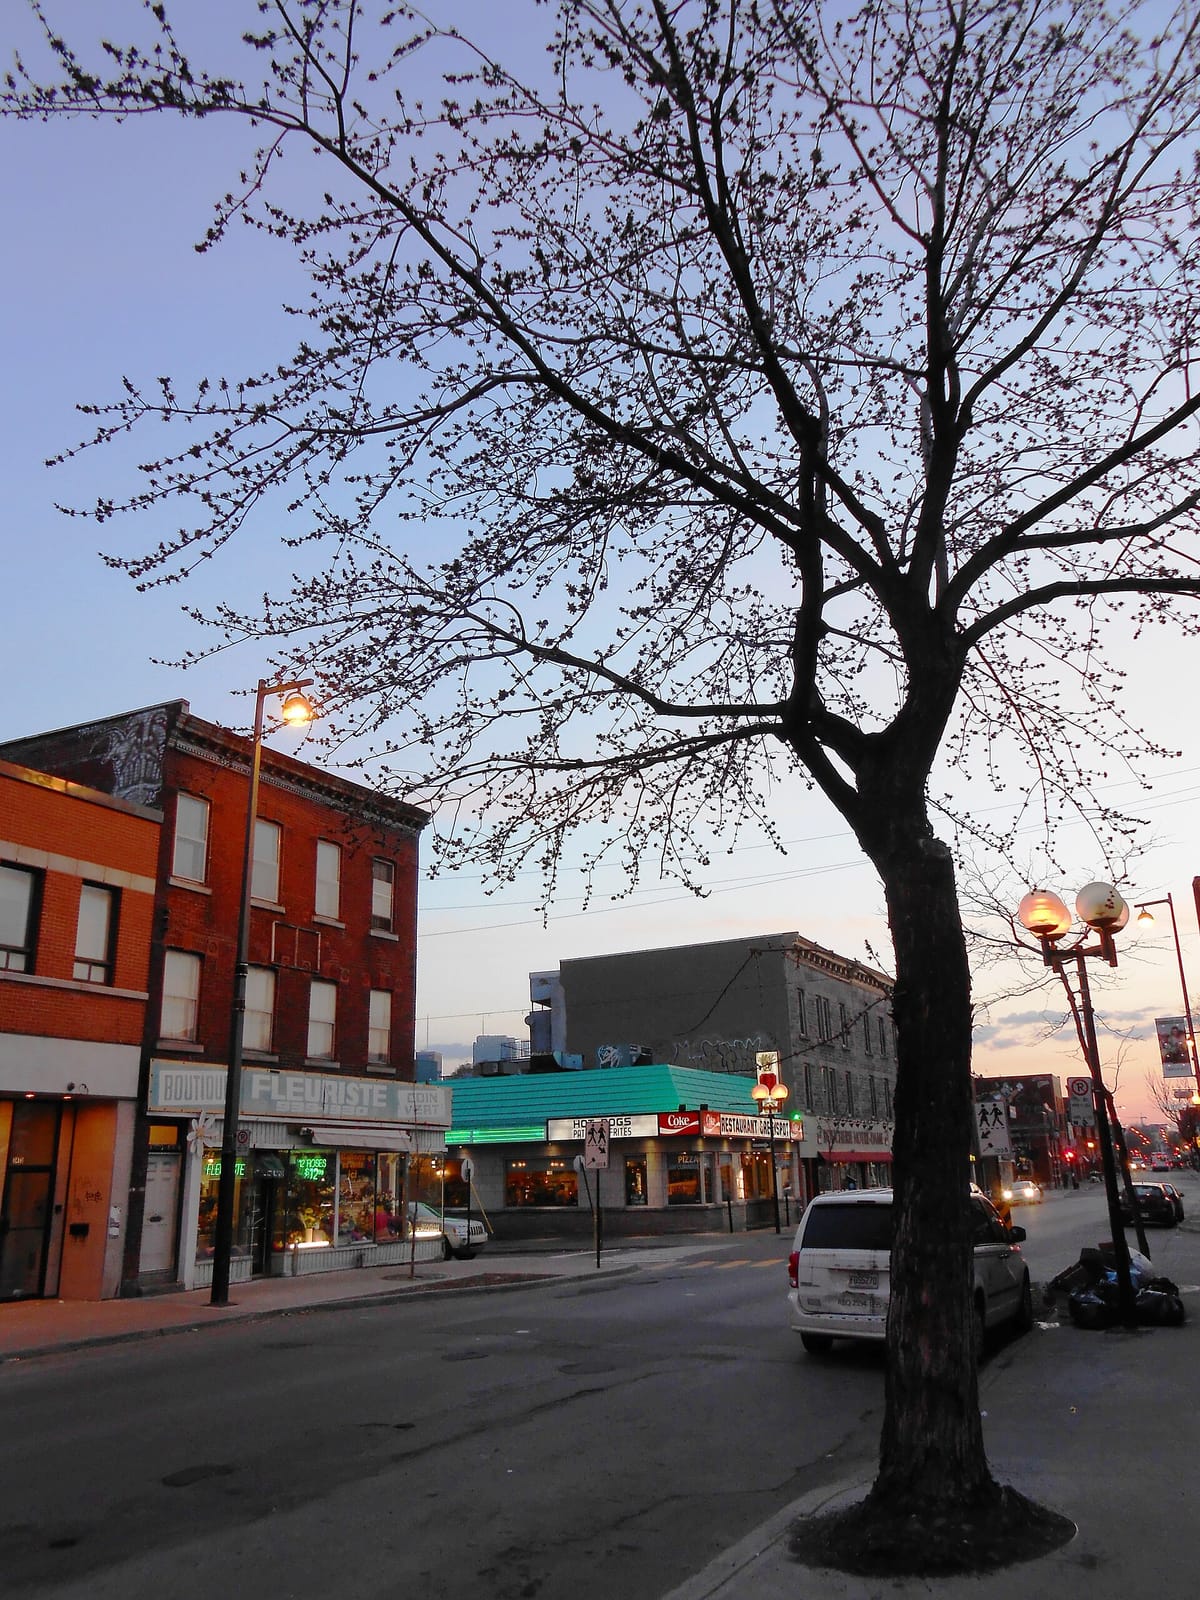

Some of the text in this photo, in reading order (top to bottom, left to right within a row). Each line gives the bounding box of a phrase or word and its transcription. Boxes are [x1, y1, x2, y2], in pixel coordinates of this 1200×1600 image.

[164, 1074, 227, 1101] BOUTIQU
[251, 1074, 388, 1108] FLEURISTE
[573, 1119, 595, 1129] HO
[667, 1114, 691, 1127] Coke
[721, 1116, 757, 1135] RESTAURANT
[759, 1119, 789, 1137] GRENSPOT
[306, 1158, 327, 1168] ROSES
[677, 1155, 699, 1164] PIZZA
